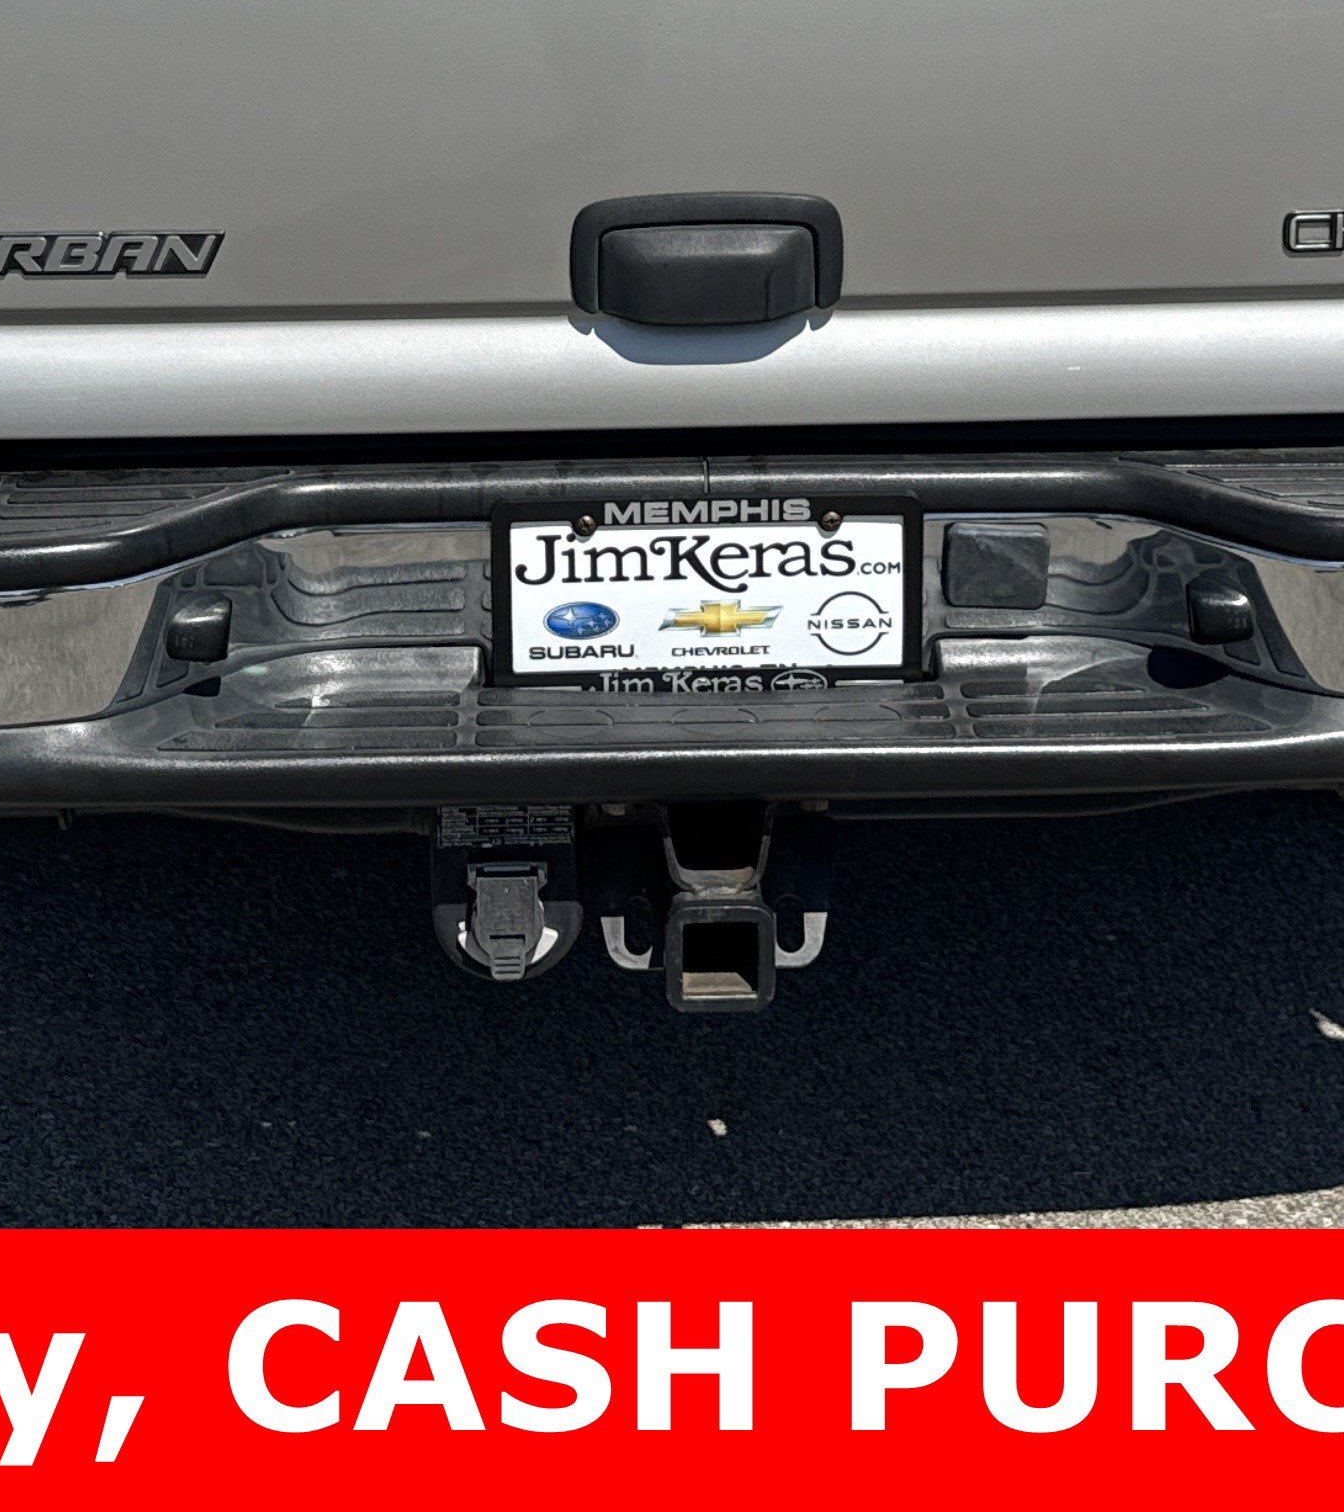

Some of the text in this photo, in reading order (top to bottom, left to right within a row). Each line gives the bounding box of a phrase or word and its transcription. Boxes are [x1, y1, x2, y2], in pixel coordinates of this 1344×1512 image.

[604, 498, 811, 525] MEMPHIS
[807, 617, 892, 631] NISSAN
[529, 644, 635, 660] SUBARU
[671, 644, 771, 657] CHEVROLET
[661, 669, 764, 693] Keras
